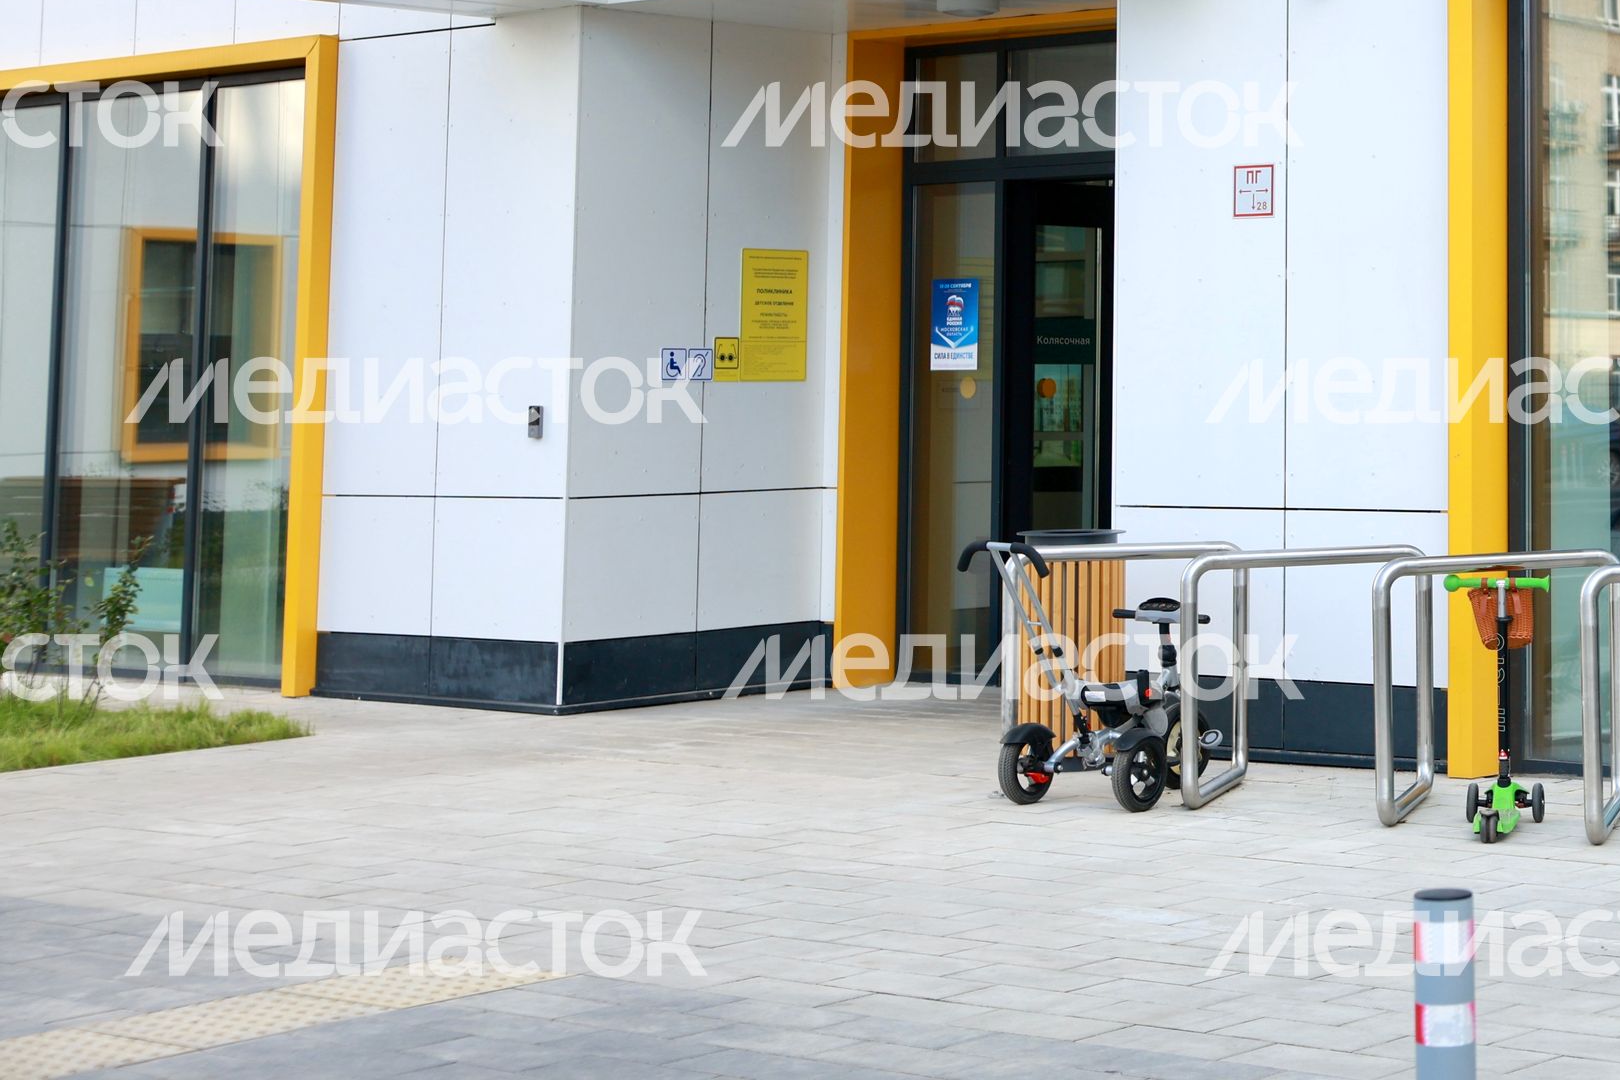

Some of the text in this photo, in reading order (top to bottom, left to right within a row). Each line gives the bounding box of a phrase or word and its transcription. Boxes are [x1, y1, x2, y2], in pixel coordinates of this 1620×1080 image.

[1246, 170, 1262, 184] ПГ
[1256, 201, 1268, 211] 28
[1036, 335, 1091, 345] Колясочная
[934, 352, 946, 360] СИЛА
